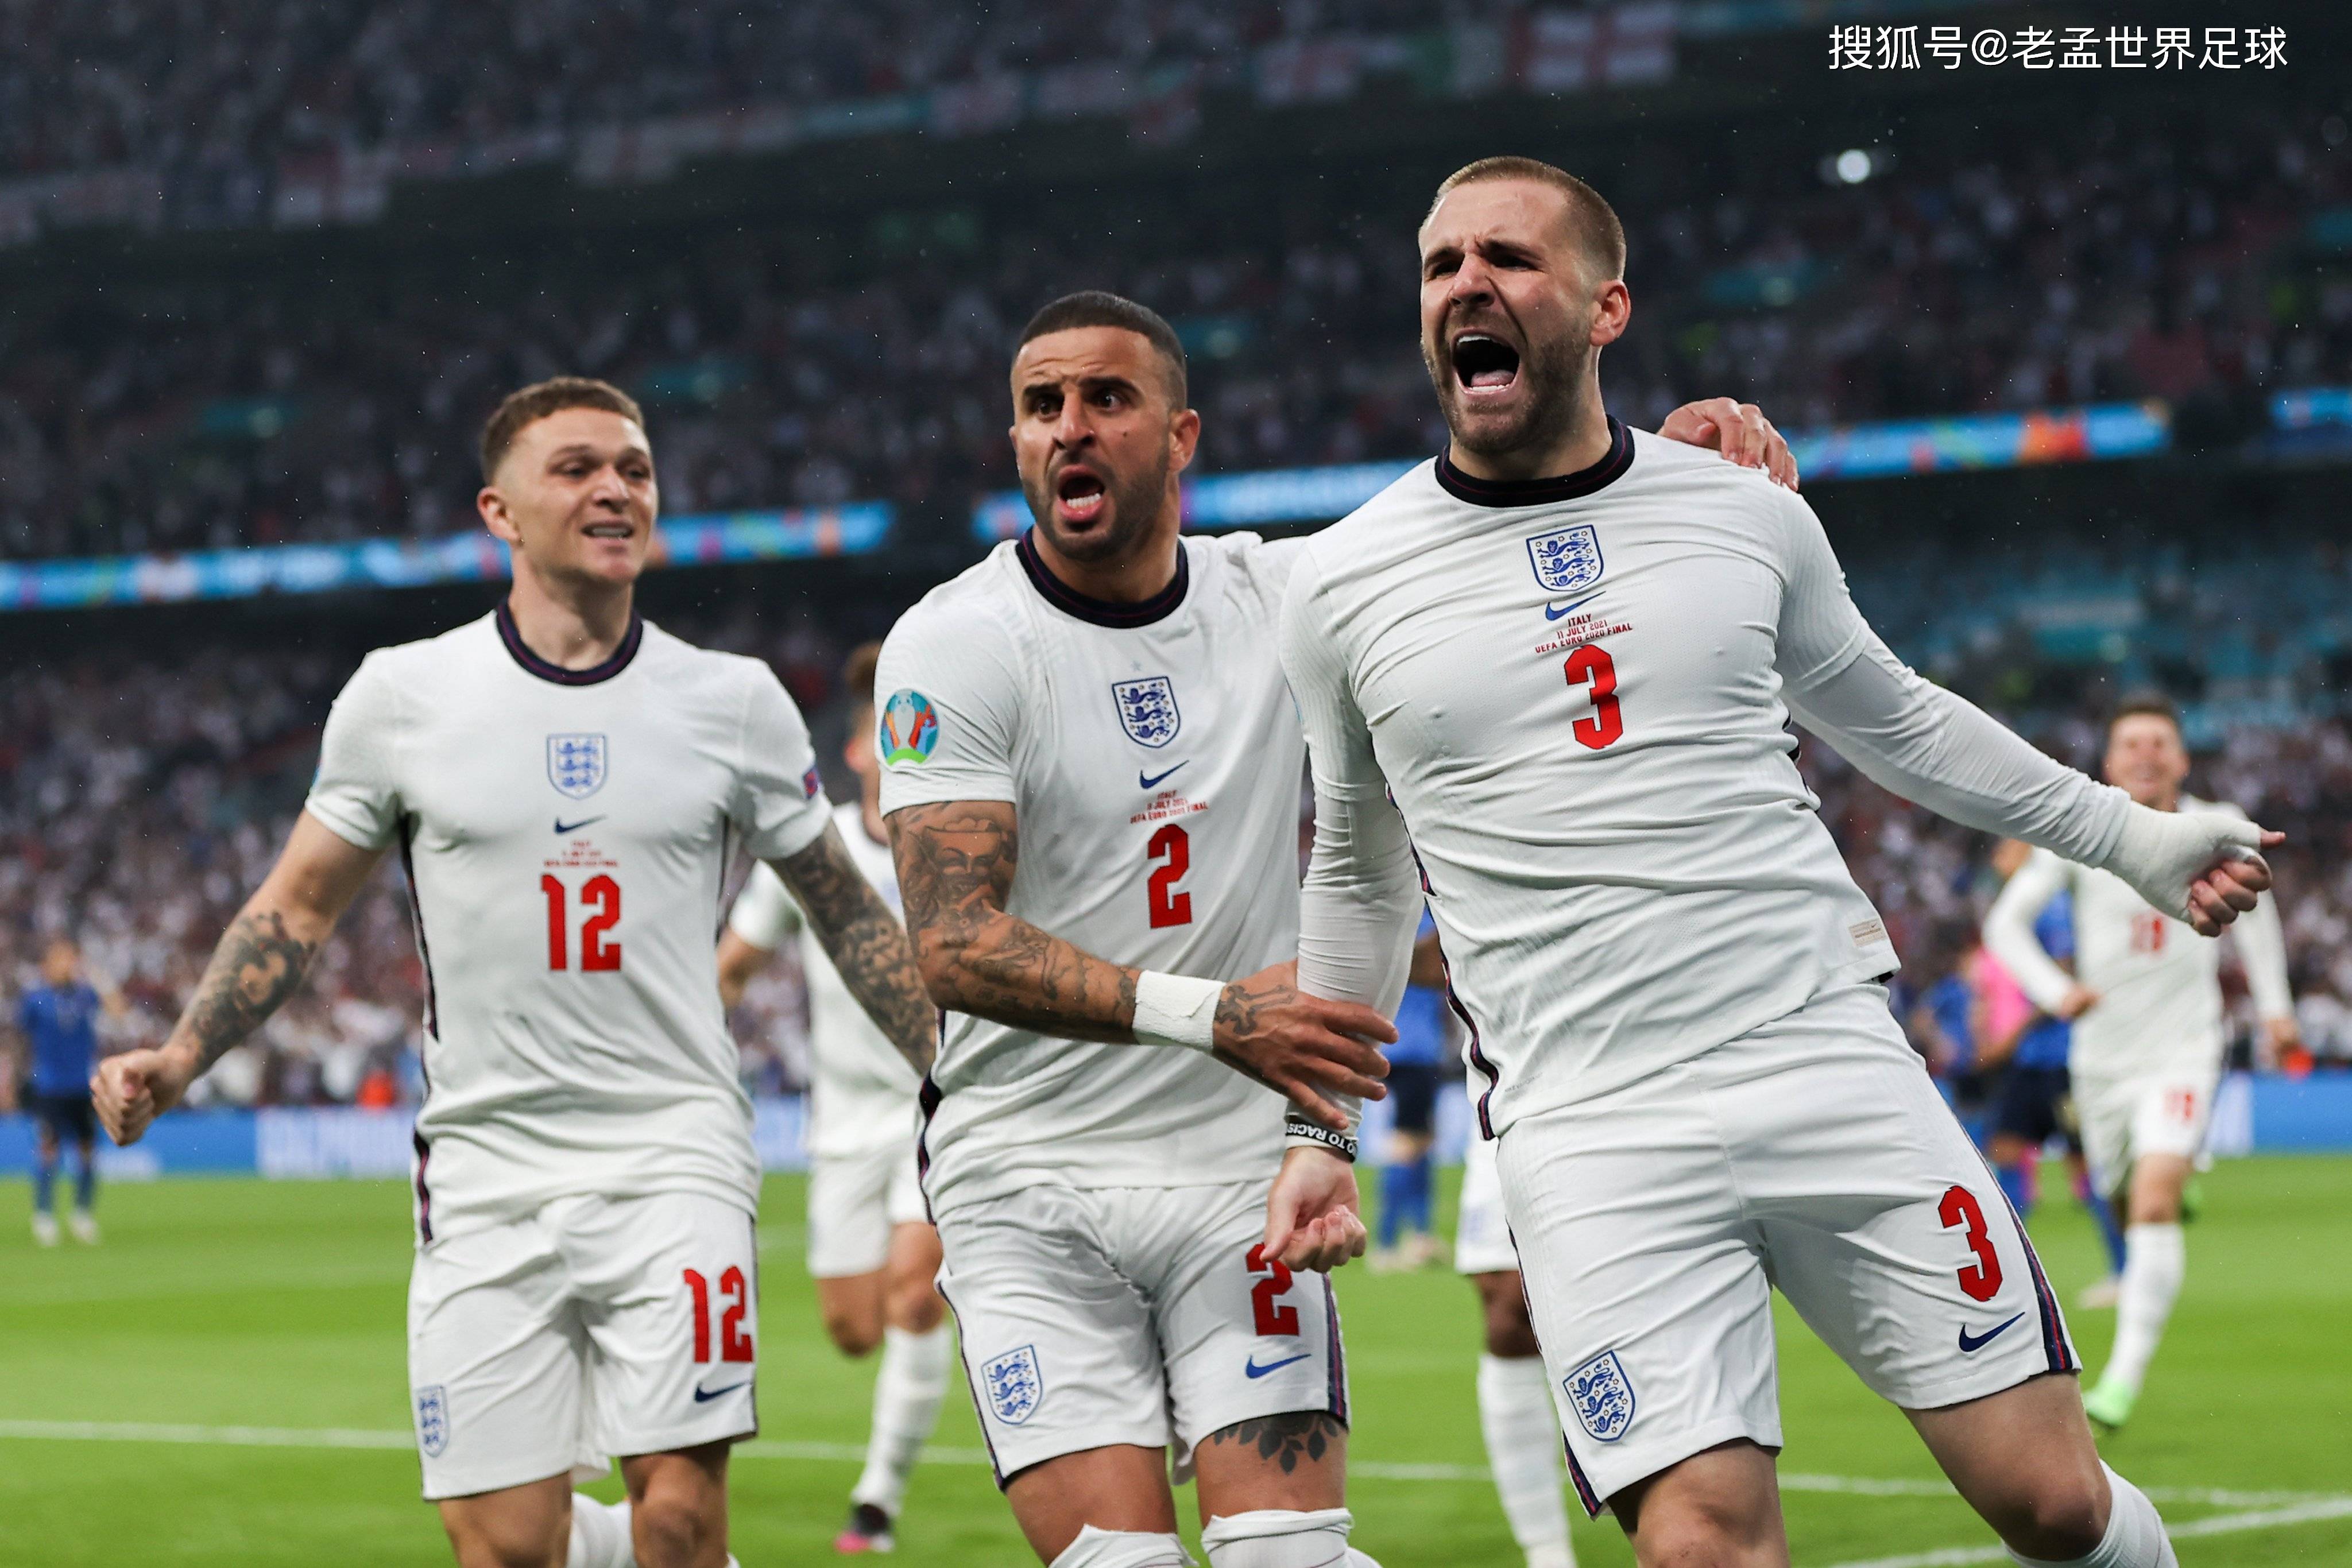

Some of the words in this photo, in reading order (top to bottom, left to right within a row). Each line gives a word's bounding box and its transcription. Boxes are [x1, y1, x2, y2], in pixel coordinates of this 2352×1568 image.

[1535, 642, 1557, 653] UEFA
[1560, 636, 1583, 646] EURO
[1585, 629, 1605, 640] 2020
[1607, 623, 1633, 636] FINAL
[1557, 630, 1564, 639] 11
[1566, 625, 1586, 637] JULY
[1589, 620, 1607, 630] 2021
[1568, 614, 1591, 627] ITALY
[1564, 644, 1623, 750] 3
[541, 873, 621, 973] 12
[1148, 823, 1193, 929] 2
[1287, 1123, 1327, 1141] RACIS
[1328, 1134, 1345, 1149] TO
[1245, 1242, 1300, 1337] 2
[1938, 1185, 2003, 1302] 3
[683, 1265, 753, 1364] 12
